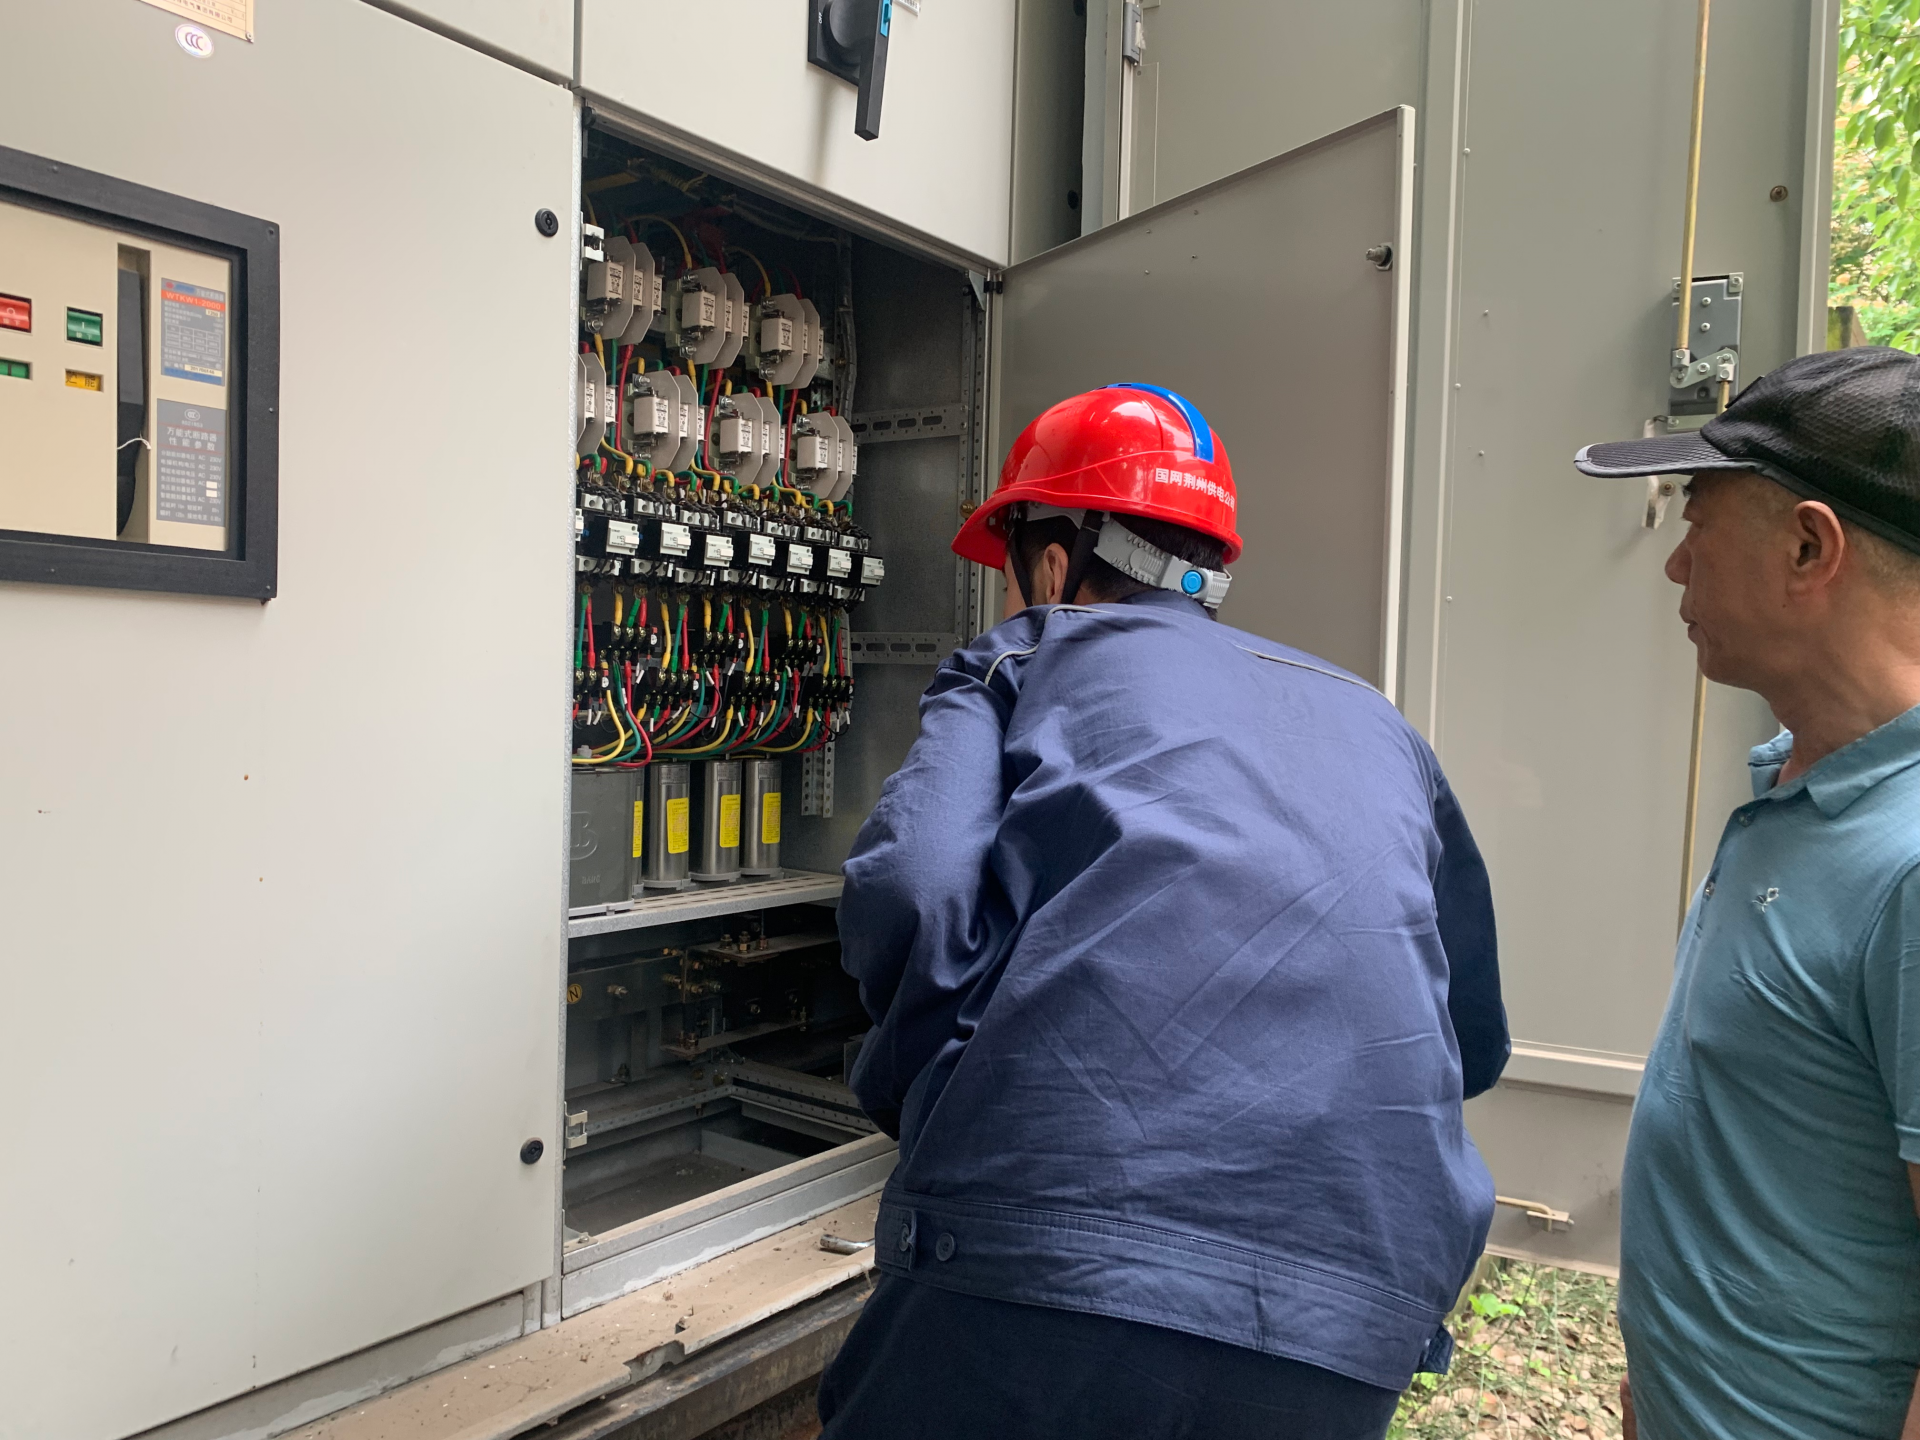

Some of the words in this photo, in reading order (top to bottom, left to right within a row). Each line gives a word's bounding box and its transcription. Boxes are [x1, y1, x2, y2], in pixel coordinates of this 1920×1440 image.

[166, 291, 221, 310] WTKW1-2000
[167, 427, 217, 442] 万能式断路器
[1155, 467, 1235, 512] 国网荆州供电公司
